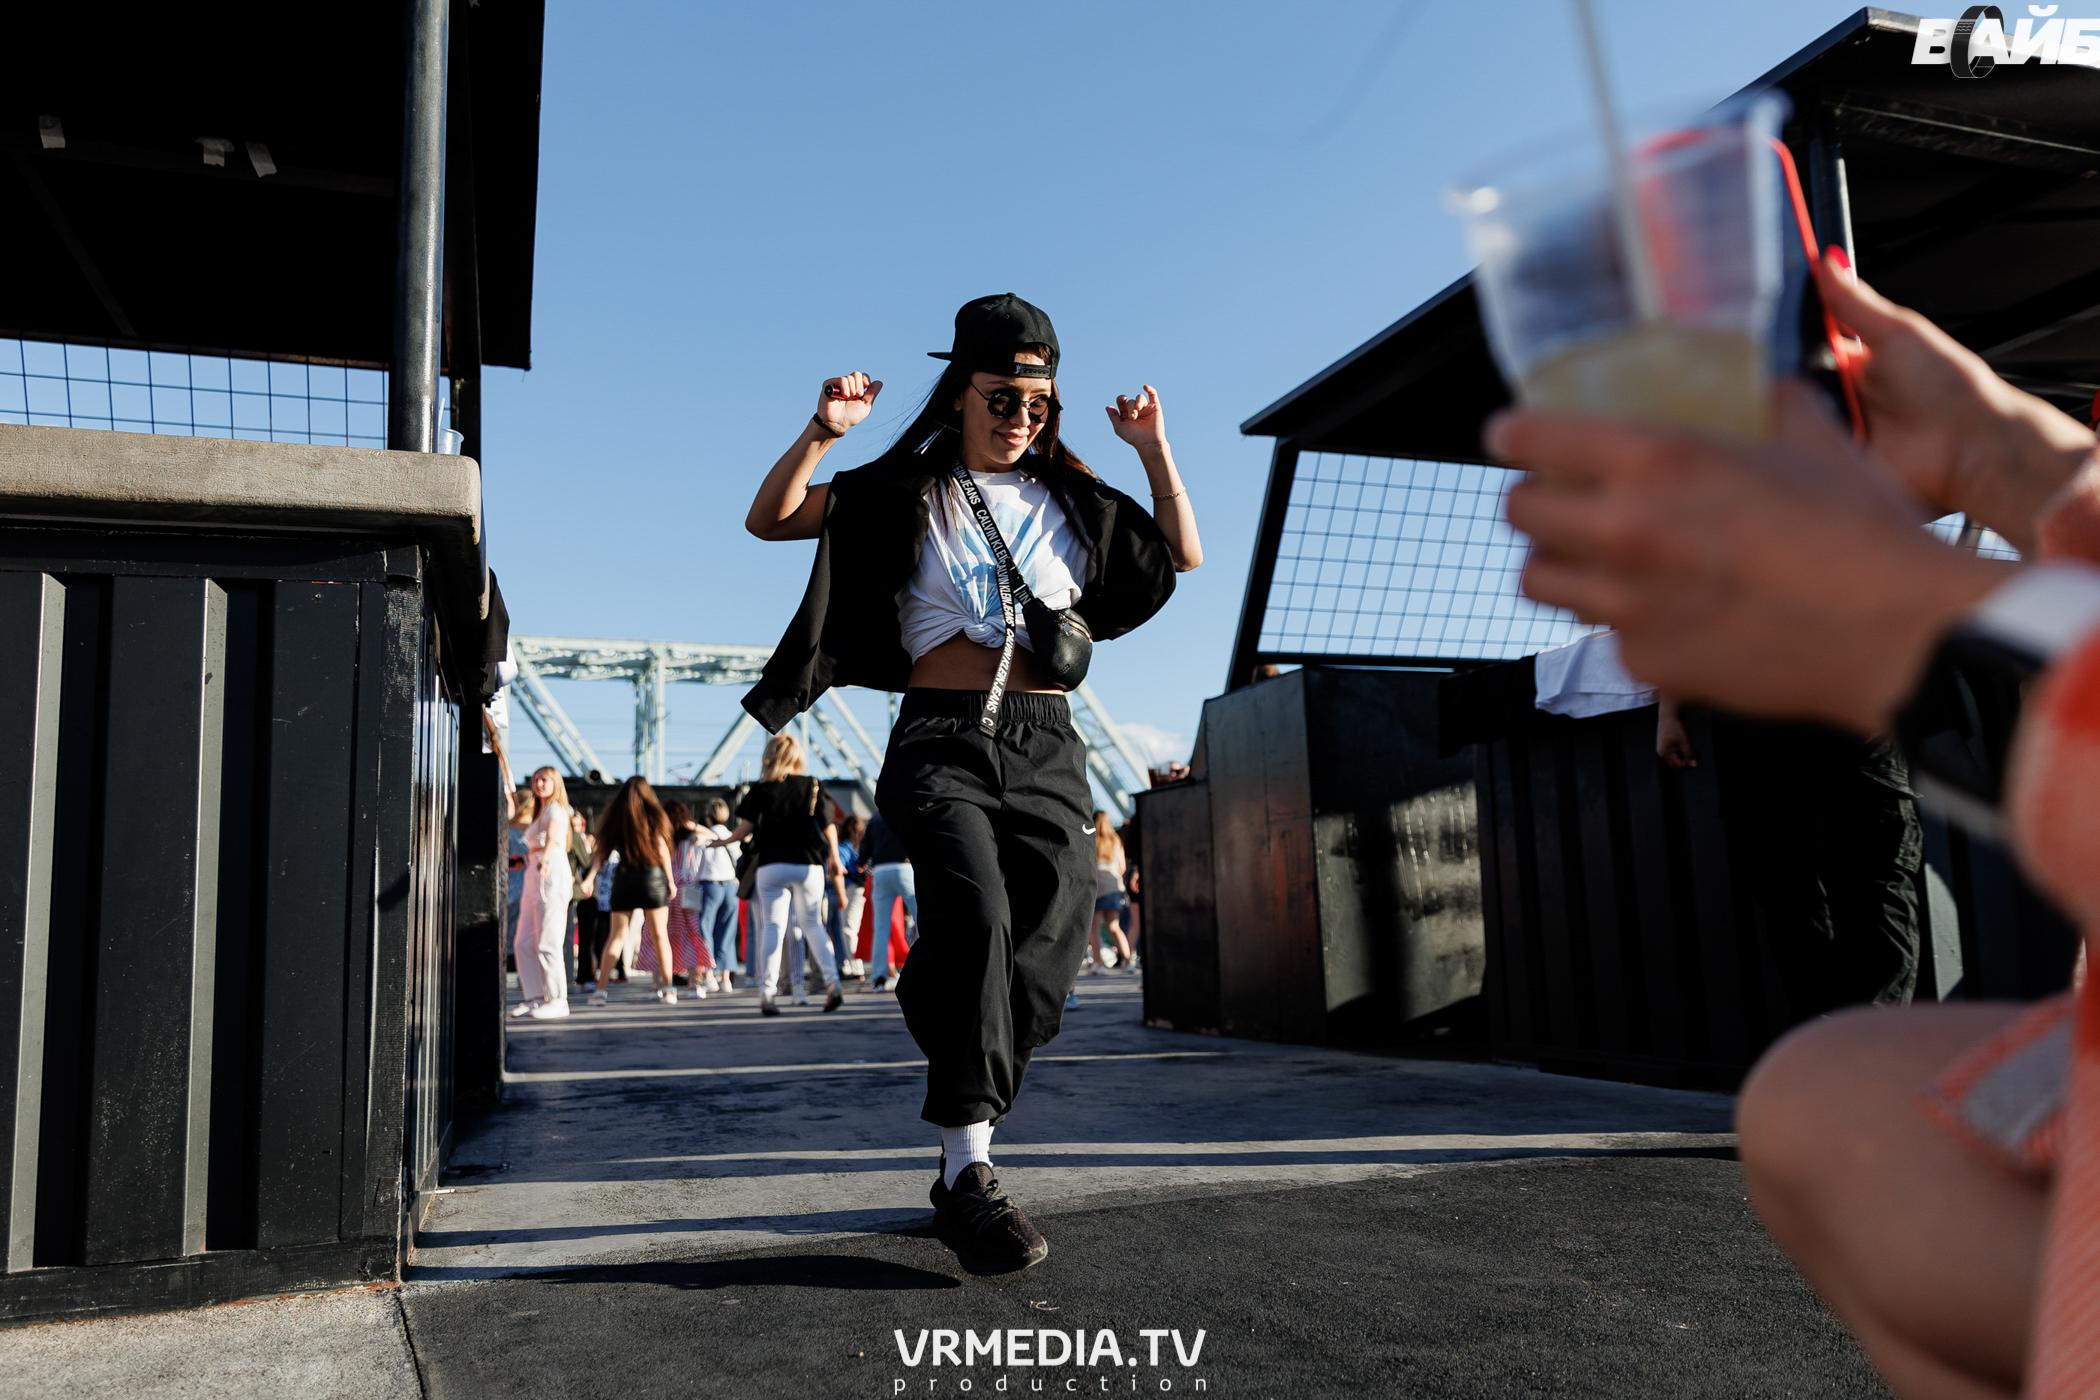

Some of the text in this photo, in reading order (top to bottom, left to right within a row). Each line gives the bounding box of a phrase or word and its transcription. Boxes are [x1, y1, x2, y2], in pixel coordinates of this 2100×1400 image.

[960, 479, 981, 505] JEANS
[976, 509, 999, 541] CALVIN
[991, 539, 1008, 561] KLEI
[996, 559, 1010, 585] CALVIN
[1000, 584, 1013, 605] KLEIN
[1003, 628, 1014, 660] CALVIN
[995, 655, 1010, 686] KLEIN
[987, 682, 1002, 714] JEANS
